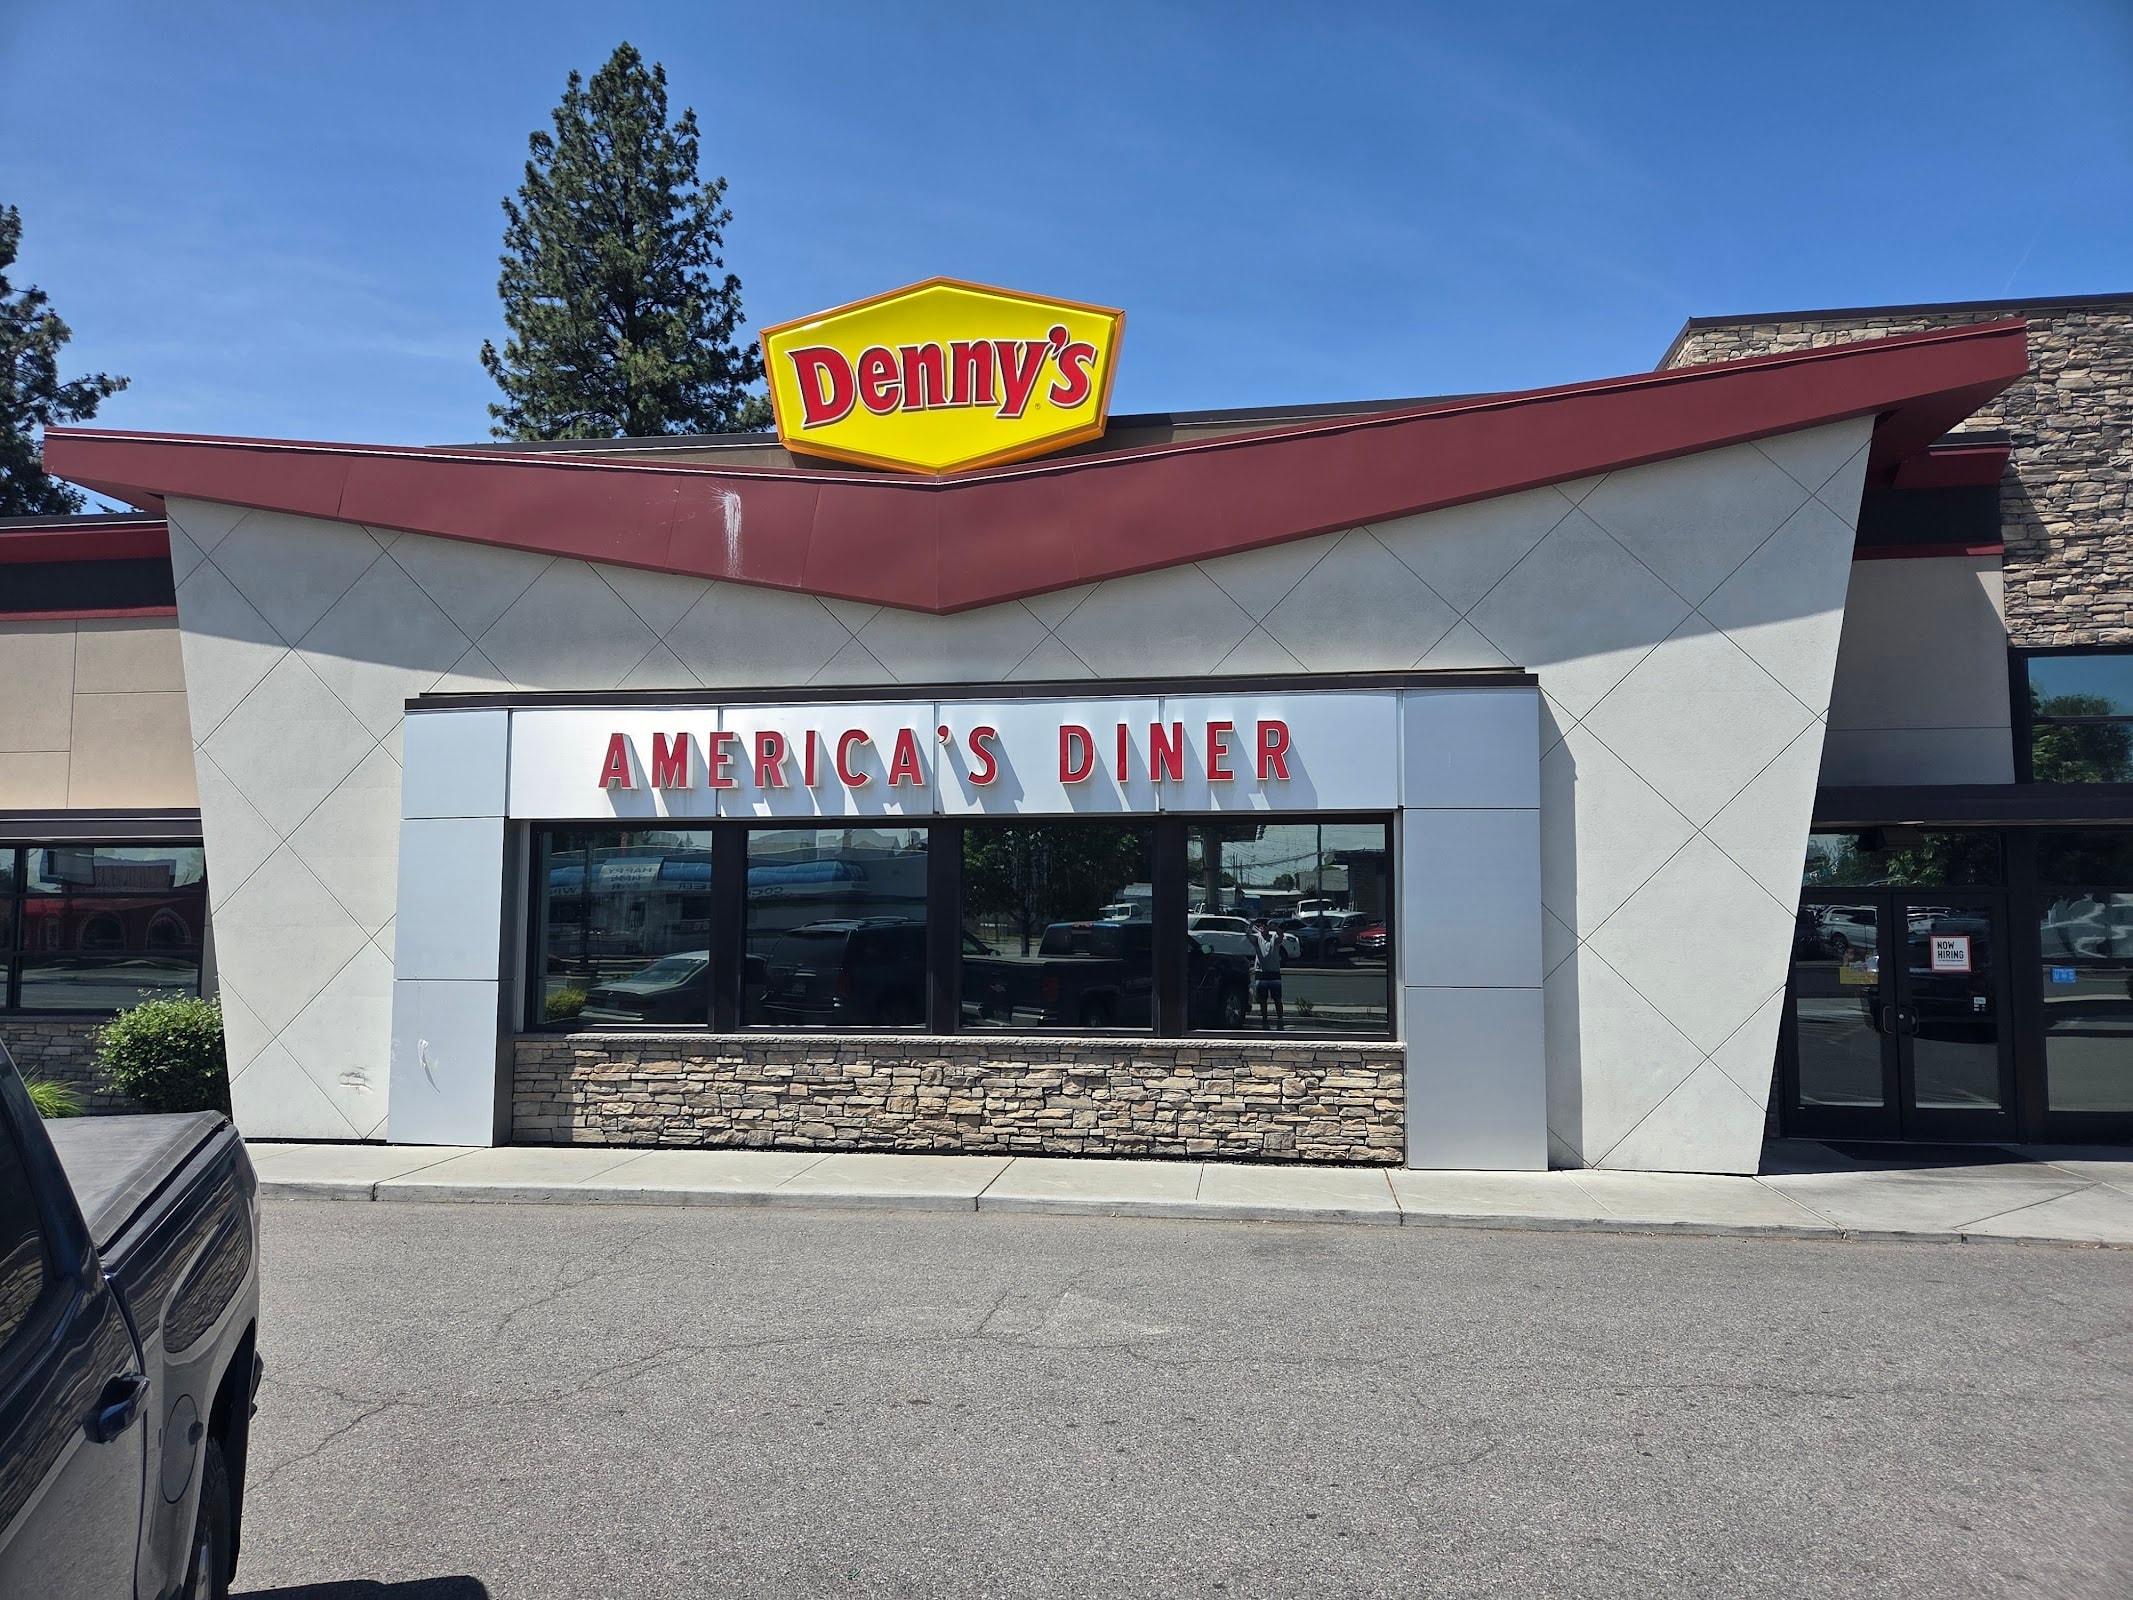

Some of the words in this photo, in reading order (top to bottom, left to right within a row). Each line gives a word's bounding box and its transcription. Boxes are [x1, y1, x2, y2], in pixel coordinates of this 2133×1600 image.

[786, 323, 1098, 429] Denny's
[598, 725, 1000, 790] AMERICA'S
[1058, 720, 1292, 784] DINER
[1937, 941, 1955, 950] NOW
[1937, 950, 1965, 959] HIRING
